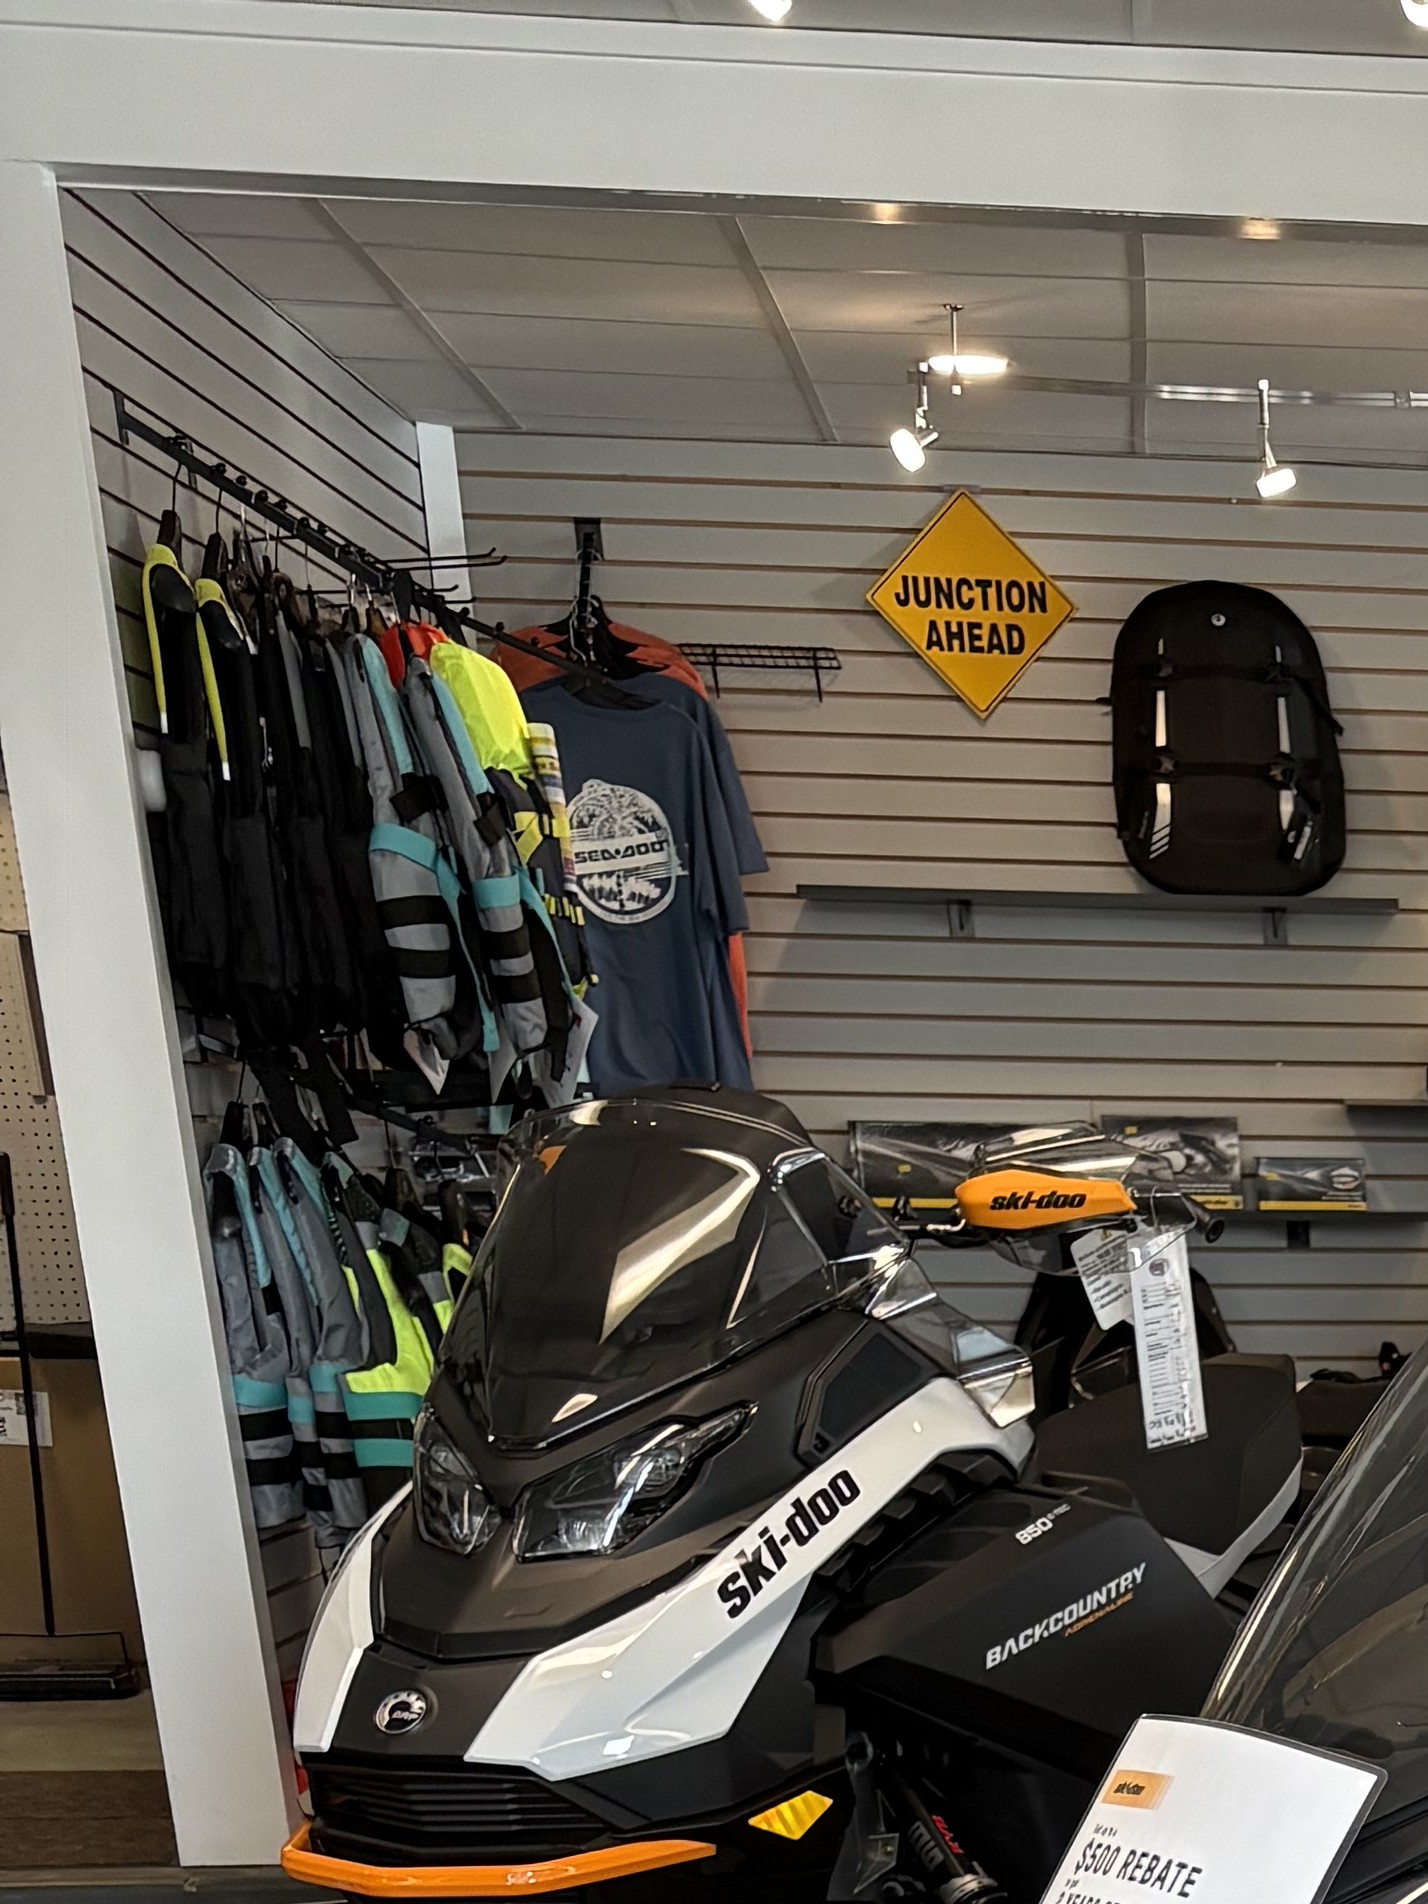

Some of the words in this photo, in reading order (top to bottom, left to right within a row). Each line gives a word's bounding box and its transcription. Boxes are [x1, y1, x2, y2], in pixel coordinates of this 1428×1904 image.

[894, 575, 1048, 614] JUNCTION
[925, 619, 1026, 656] AHEAD
[989, 1189, 1087, 1211] ski-doo
[716, 1469, 862, 1620] ski-doo
[1014, 1516, 1054, 1546] 850
[985, 1562, 1148, 1671] BACKCOUNTRY
[1073, 1837, 1122, 1876] $500
[1116, 1848, 1203, 1899] REBATE
